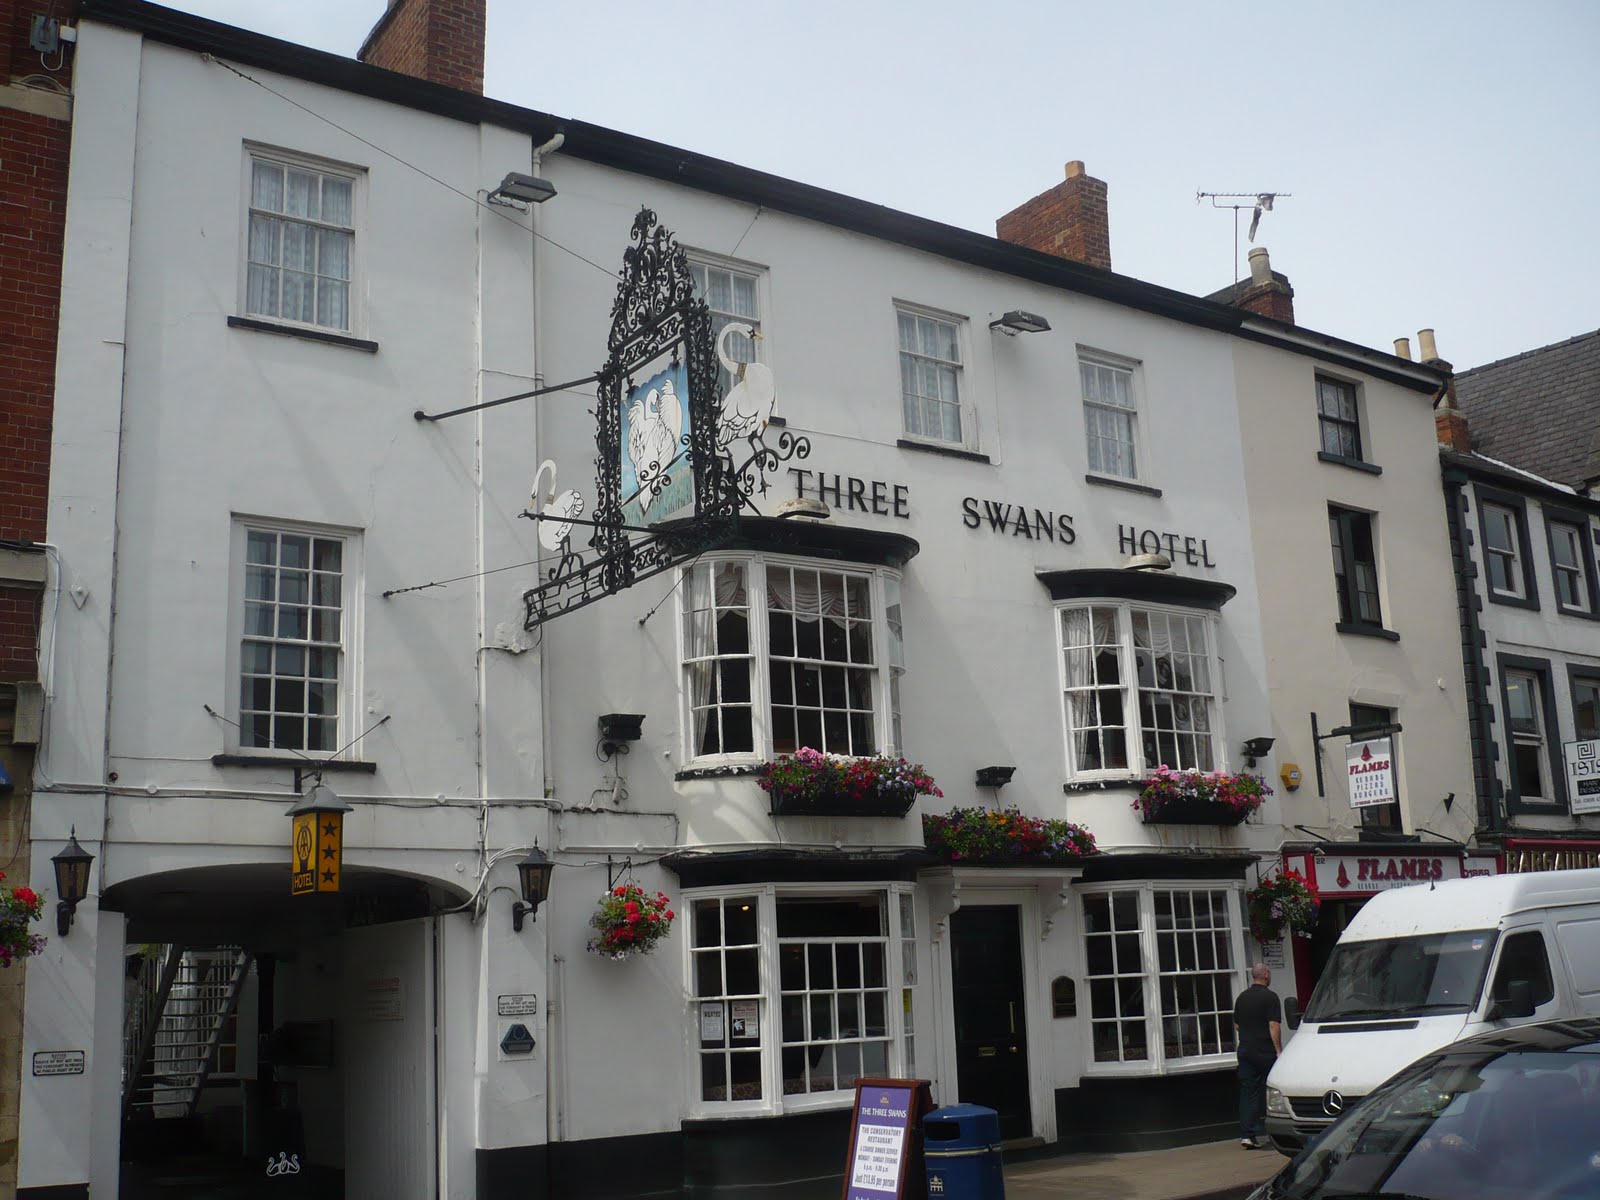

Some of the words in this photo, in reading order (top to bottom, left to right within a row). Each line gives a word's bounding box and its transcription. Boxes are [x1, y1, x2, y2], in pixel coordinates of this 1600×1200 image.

[787, 467, 910, 520] THREE
[962, 497, 1077, 545] SWANS
[1117, 524, 1217, 568] HOTEL
[1349, 760, 1390, 775] FLAMES
[1355, 774, 1384, 784] KEBABS
[1356, 781, 1384, 790] PIZZAS
[1354, 788, 1389, 799] BURGERS
[1357, 858, 1443, 881] FLAMES
[294, 873, 313, 889] HOTEL
[861, 1107, 871, 1116] THE
[872, 1107, 887, 1117] THREE
[888, 1109, 907, 1118] SWANS
[861, 1126, 870, 1134] THE
[870, 1127, 902, 1137] CONSERVATORY
[867, 1136, 894, 1144] RESTAURANT
[882, 1178, 896, 1188] person
